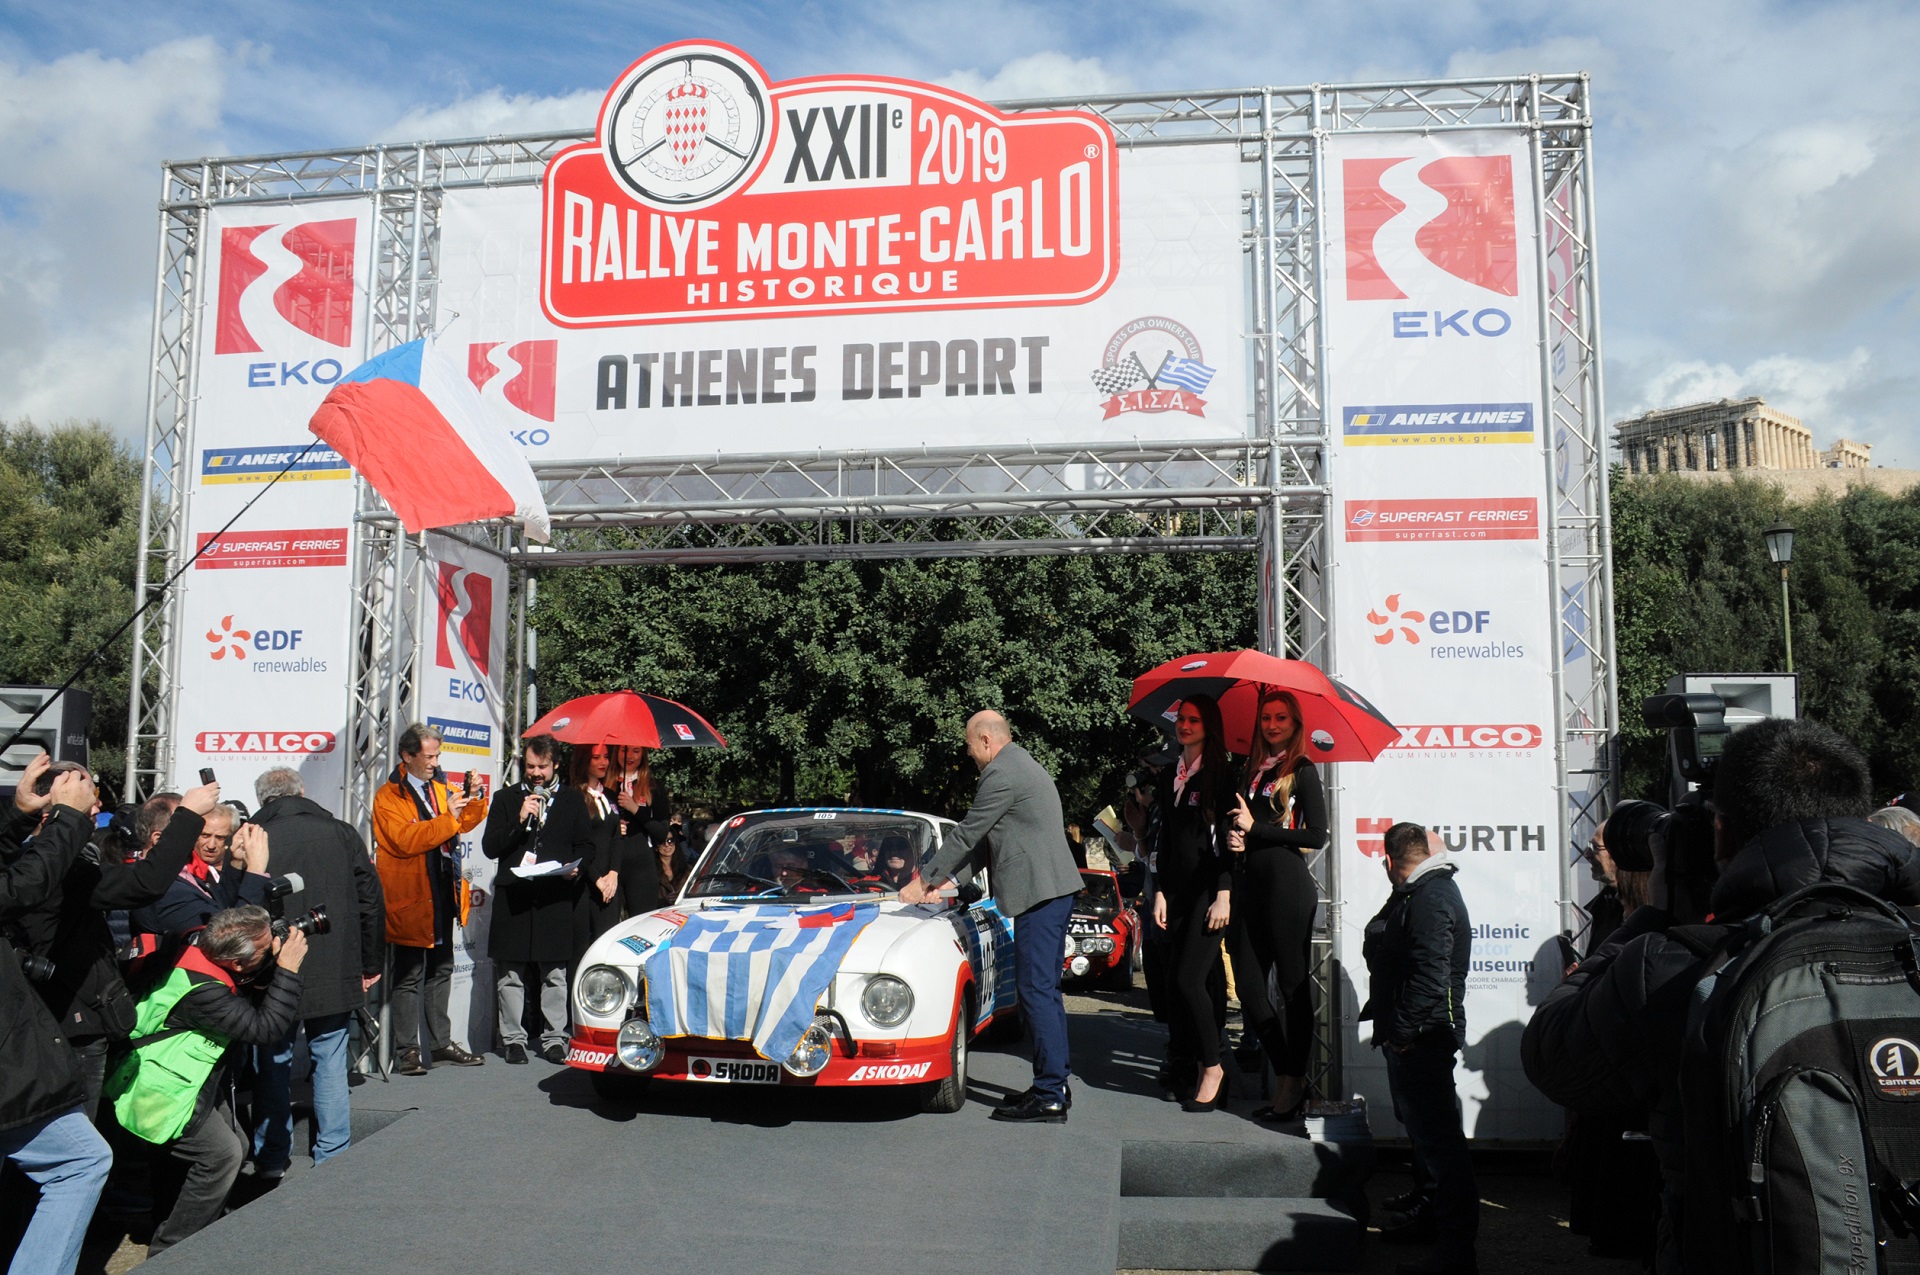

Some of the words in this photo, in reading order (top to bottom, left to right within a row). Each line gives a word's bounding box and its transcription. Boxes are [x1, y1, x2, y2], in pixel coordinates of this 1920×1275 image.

[917, 107, 1006, 186] 2019
[561, 189, 720, 285] RALLYE
[737, 161, 1091, 273] MONTE-CARLO
[686, 269, 959, 305] HISTORIQUE
[1393, 308, 1512, 338] EKO
[1106, 331, 1127, 363] SPORTS
[1127, 320, 1146, 333] CAR
[1147, 318, 1186, 339] OWNERS
[1185, 336, 1200, 360] CLUB
[247, 358, 343, 388] EKO
[596, 345, 818, 410] ATHENES
[841, 335, 1050, 402] DEPART
[1390, 412, 1458, 426] ANEK
[1459, 410, 1525, 425] LINES
[510, 428, 550, 446] KO
[1391, 435, 1488, 446] www.anek.gr
[237, 453, 292, 466] ANEK
[293, 451, 343, 464] LINES
[1379, 511, 1465, 523] SUPERFAST
[1468, 509, 1529, 522] FERRIES
[1395, 528, 1487, 540] superfast.com
[222, 541, 289, 553] SUPERFAST
[292, 540, 341, 551] FERRIES
[233, 558, 306, 568] superfast.com
[1430, 641, 1524, 659] renewables
[253, 657, 327, 673] renewables
[449, 678, 486, 703] EKO
[443, 725, 467, 738] ANEK
[467, 730, 489, 741] LINES
[1388, 727, 1532, 747] XALCO
[204, 733, 328, 752] EXALCO
[1426, 825, 1545, 852] ÜRTH
[1067, 924, 1114, 934] ALIA
[1471, 923, 1530, 939] ellenic
[1472, 942, 1512, 956] otor
[1468, 960, 1535, 972] useum
[715, 1062, 779, 1081] SKODA
[866, 1063, 921, 1080] SKODA
